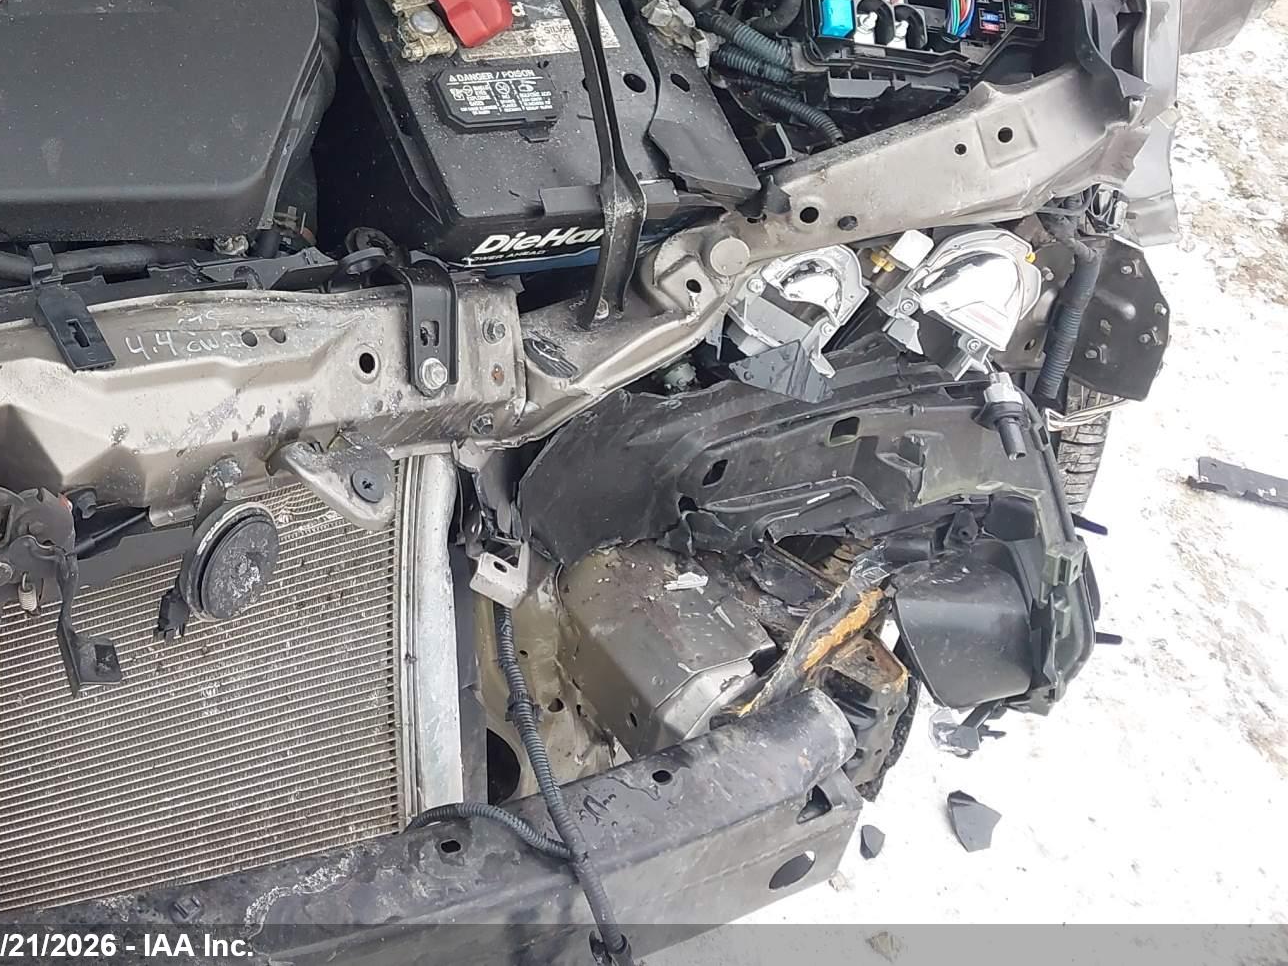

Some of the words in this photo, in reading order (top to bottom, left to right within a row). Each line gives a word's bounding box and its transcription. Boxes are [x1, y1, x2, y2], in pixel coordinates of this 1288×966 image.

[456, 72, 494, 82] DANGER
[501, 69, 536, 78] POISON
[472, 226, 605, 255] DieHar
